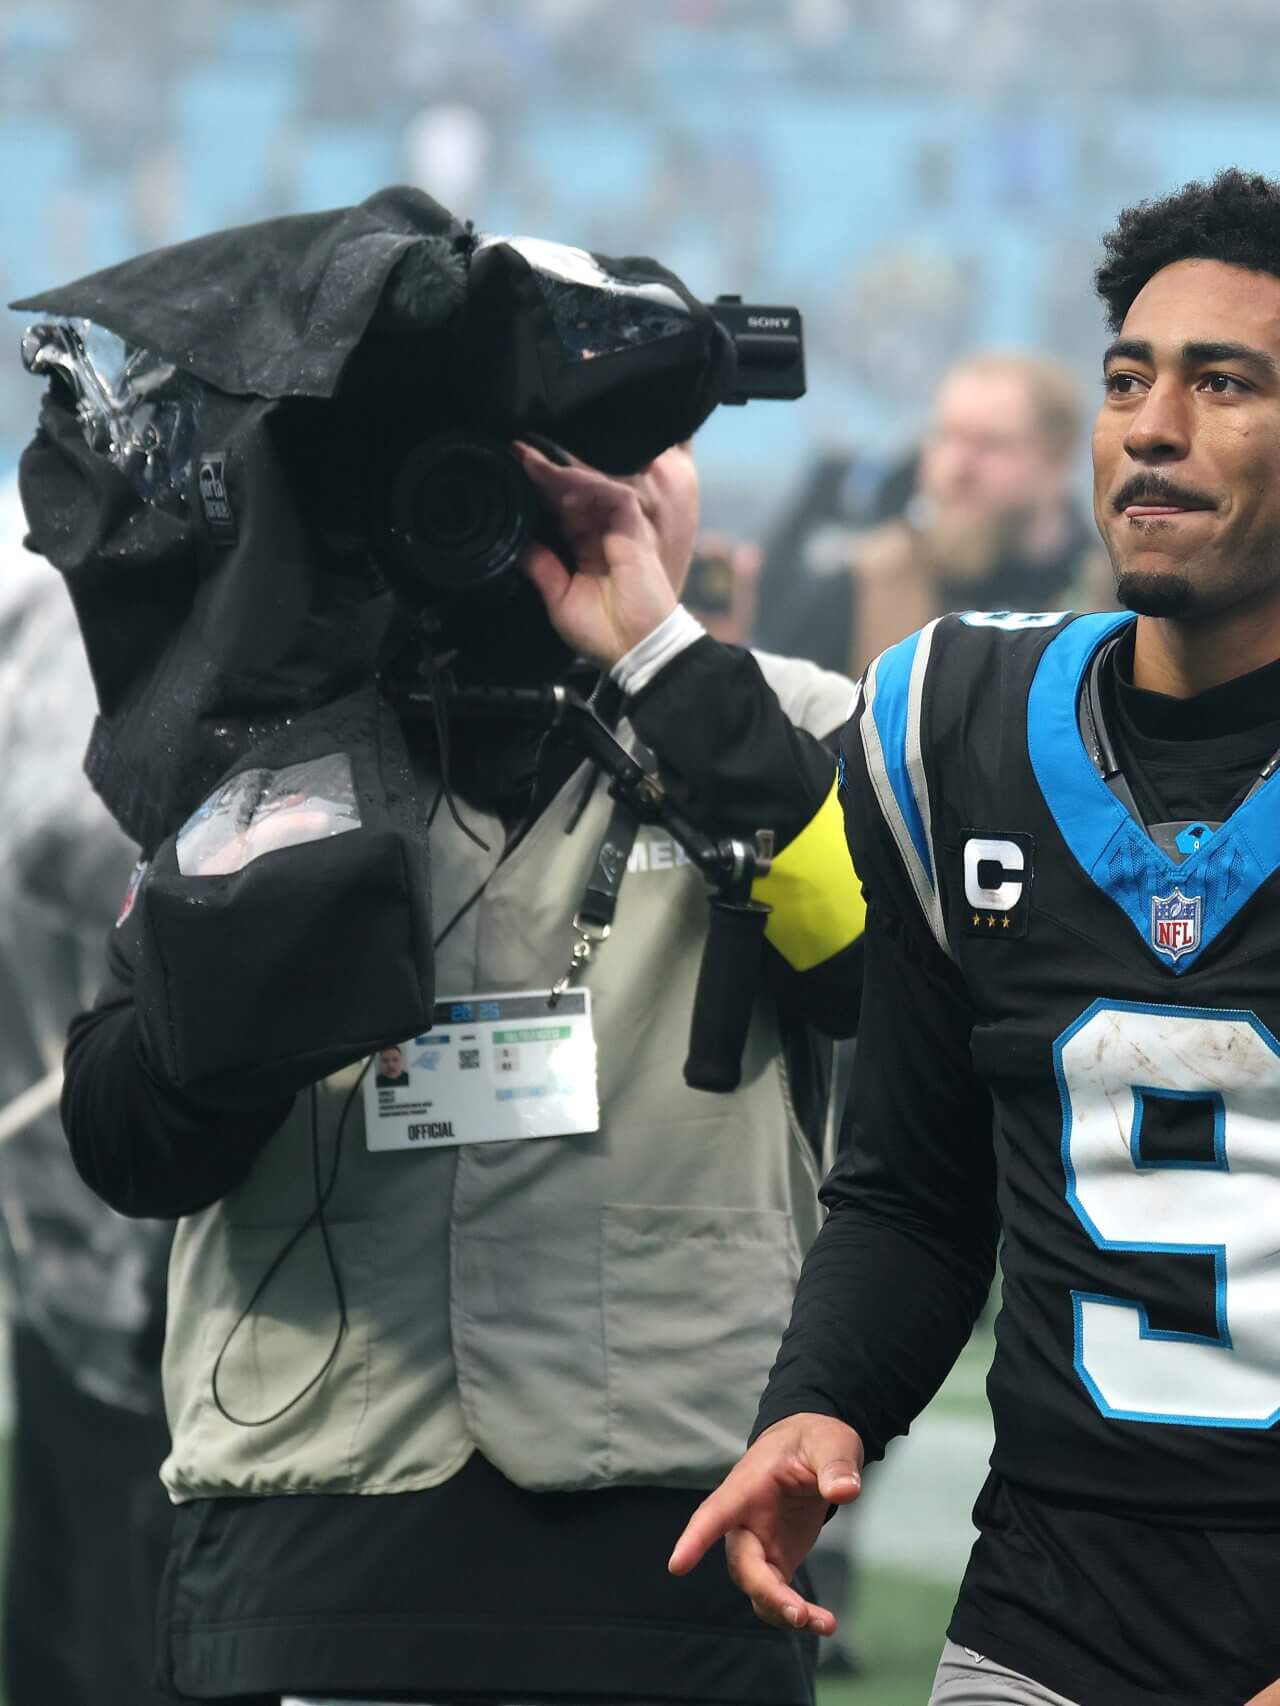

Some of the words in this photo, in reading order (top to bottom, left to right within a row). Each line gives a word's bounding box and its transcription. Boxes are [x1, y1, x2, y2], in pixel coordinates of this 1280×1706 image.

[747, 316, 790, 329] SONY
[963, 838, 1025, 911] C
[1158, 921, 1193, 949] NFL
[408, 1121, 456, 1141] OFFICIAL
